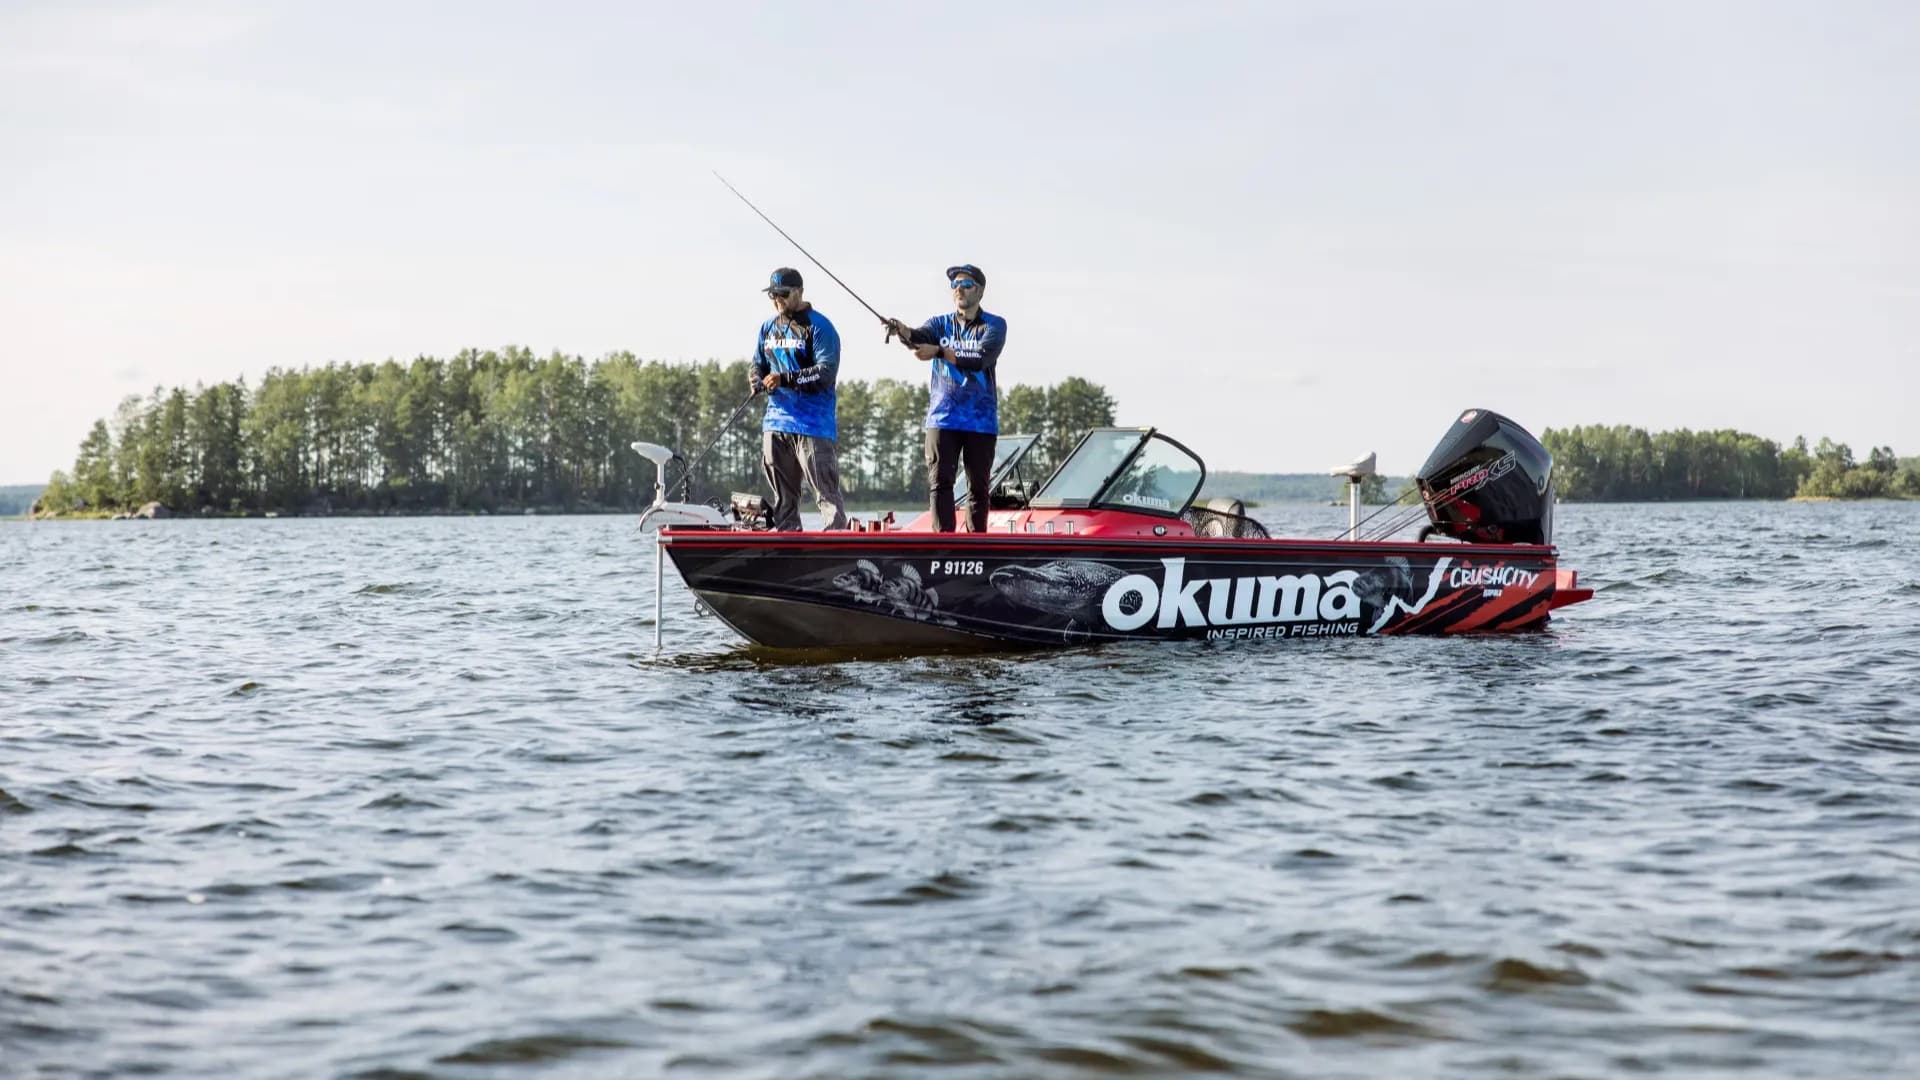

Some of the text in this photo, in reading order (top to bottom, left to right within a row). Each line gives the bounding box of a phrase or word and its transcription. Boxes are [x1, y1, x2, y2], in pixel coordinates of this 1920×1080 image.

[1123, 491, 1170, 510] okuma
[930, 560, 984, 575] P 91126
[1102, 557, 1361, 631] okuma
[1206, 622, 1359, 640] INSPIRED FISHING
